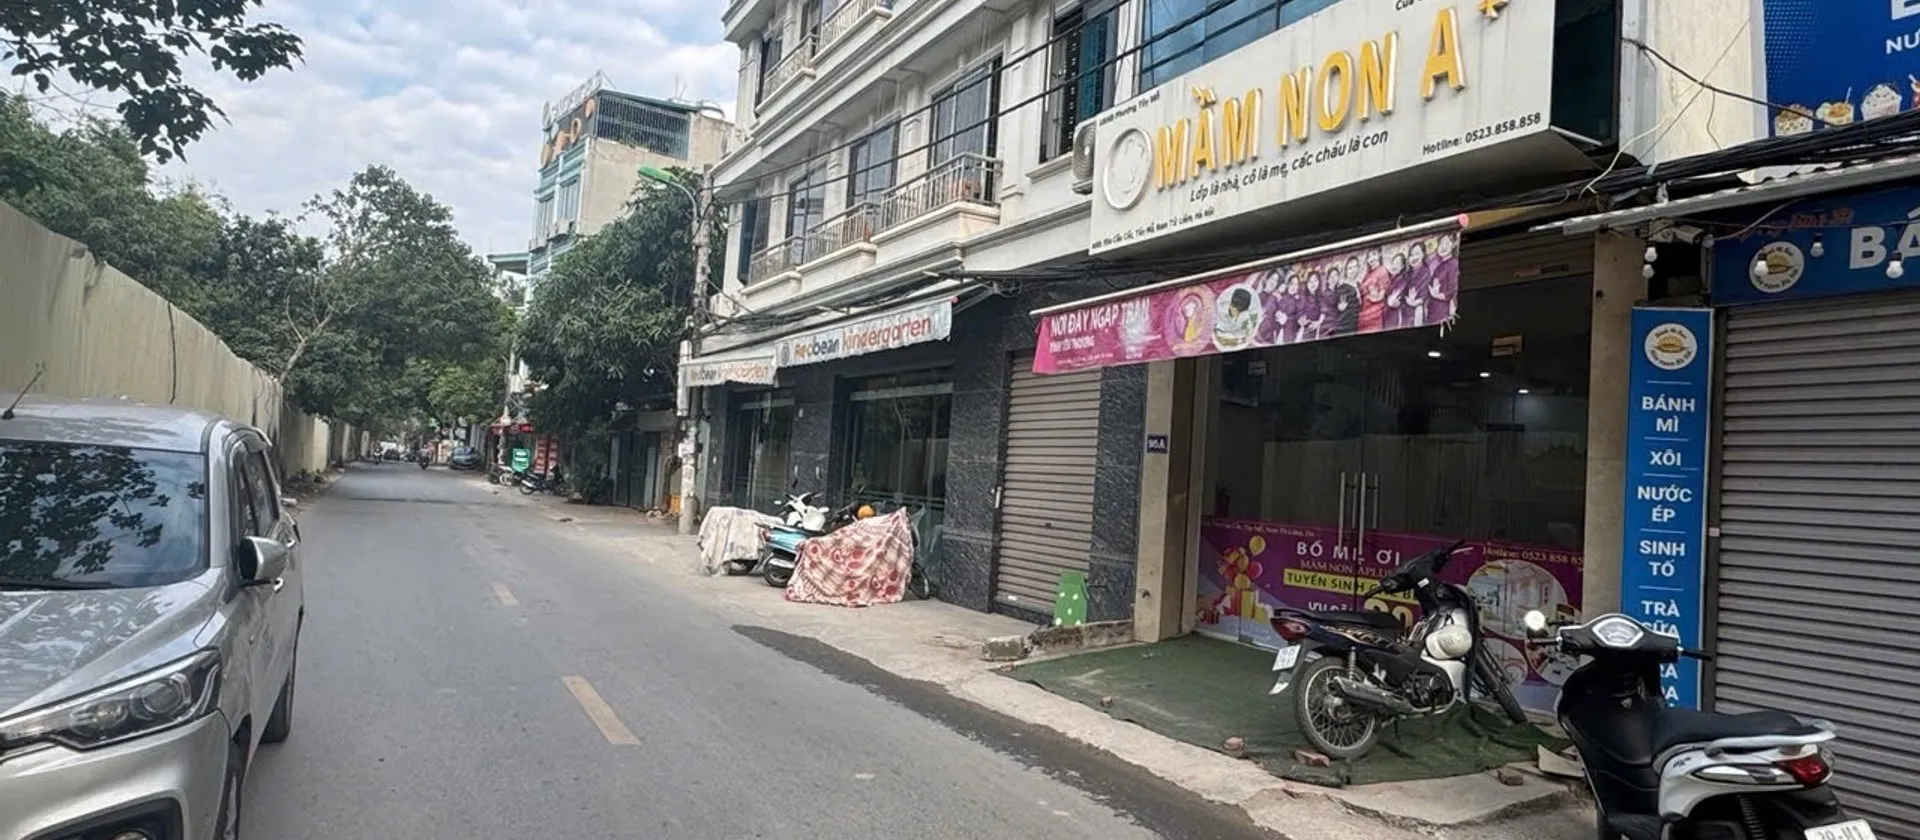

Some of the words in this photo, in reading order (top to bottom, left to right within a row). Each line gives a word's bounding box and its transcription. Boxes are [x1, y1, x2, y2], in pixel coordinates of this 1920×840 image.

[1154, 86, 1262, 191] MẦM
[1277, 31, 1398, 147] NON
[1422, 136, 1462, 156] Hotline:
[1465, 112, 1541, 144] 0523.858.858
[1190, 184, 1208, 202] Lớp
[1209, 178, 1219, 197] là
[1242, 169, 1256, 187] cô
[1257, 164, 1268, 183] là
[1291, 151, 1314, 171] các
[1315, 141, 1347, 164] cháu
[1348, 135, 1360, 154] là
[1362, 129, 1389, 150] con
[842, 315, 932, 351] kindergarten
[1641, 393, 1696, 412] BÁNH
[1656, 415, 1679, 433] MÌ
[1650, 449, 1681, 466] XÔI
[1637, 484, 1693, 503] NƯỚC
[1651, 505, 1676, 522] ÉP
[1297, 540, 1323, 558] BỐ
[1376, 549, 1400, 566] ƠI
[1639, 540, 1686, 557] SINH
[1649, 559, 1676, 577] TỐ
[1331, 578, 1365, 592] SINH
[1641, 599, 1681, 618] TRÀ
